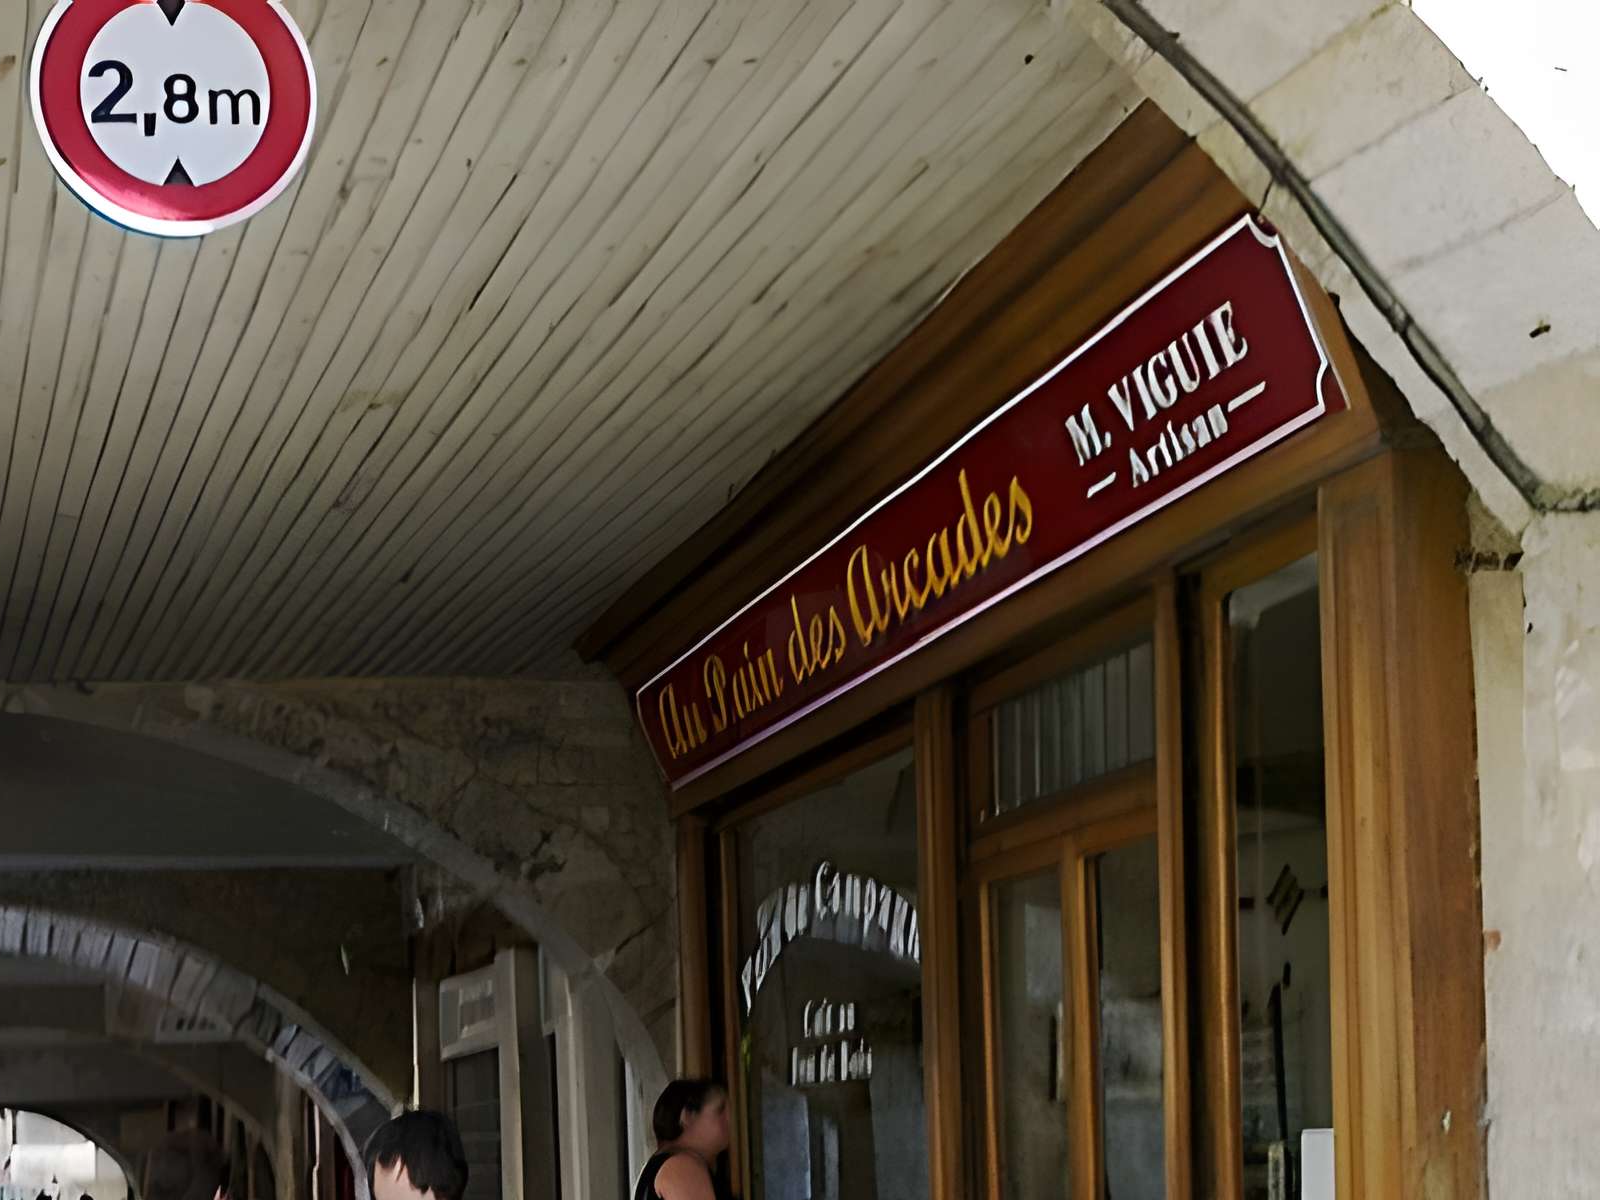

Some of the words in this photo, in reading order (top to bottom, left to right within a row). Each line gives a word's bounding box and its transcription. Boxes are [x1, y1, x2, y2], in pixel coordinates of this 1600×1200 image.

[88, 60, 261, 137] 2,8m
[1064, 402, 1112, 467] M.
[1128, 403, 1229, 489] Artisan
[659, 682, 708, 760] Au
[703, 640, 784, 734] Pain
[788, 593, 847, 685] des
[846, 468, 1033, 648] Arcades
